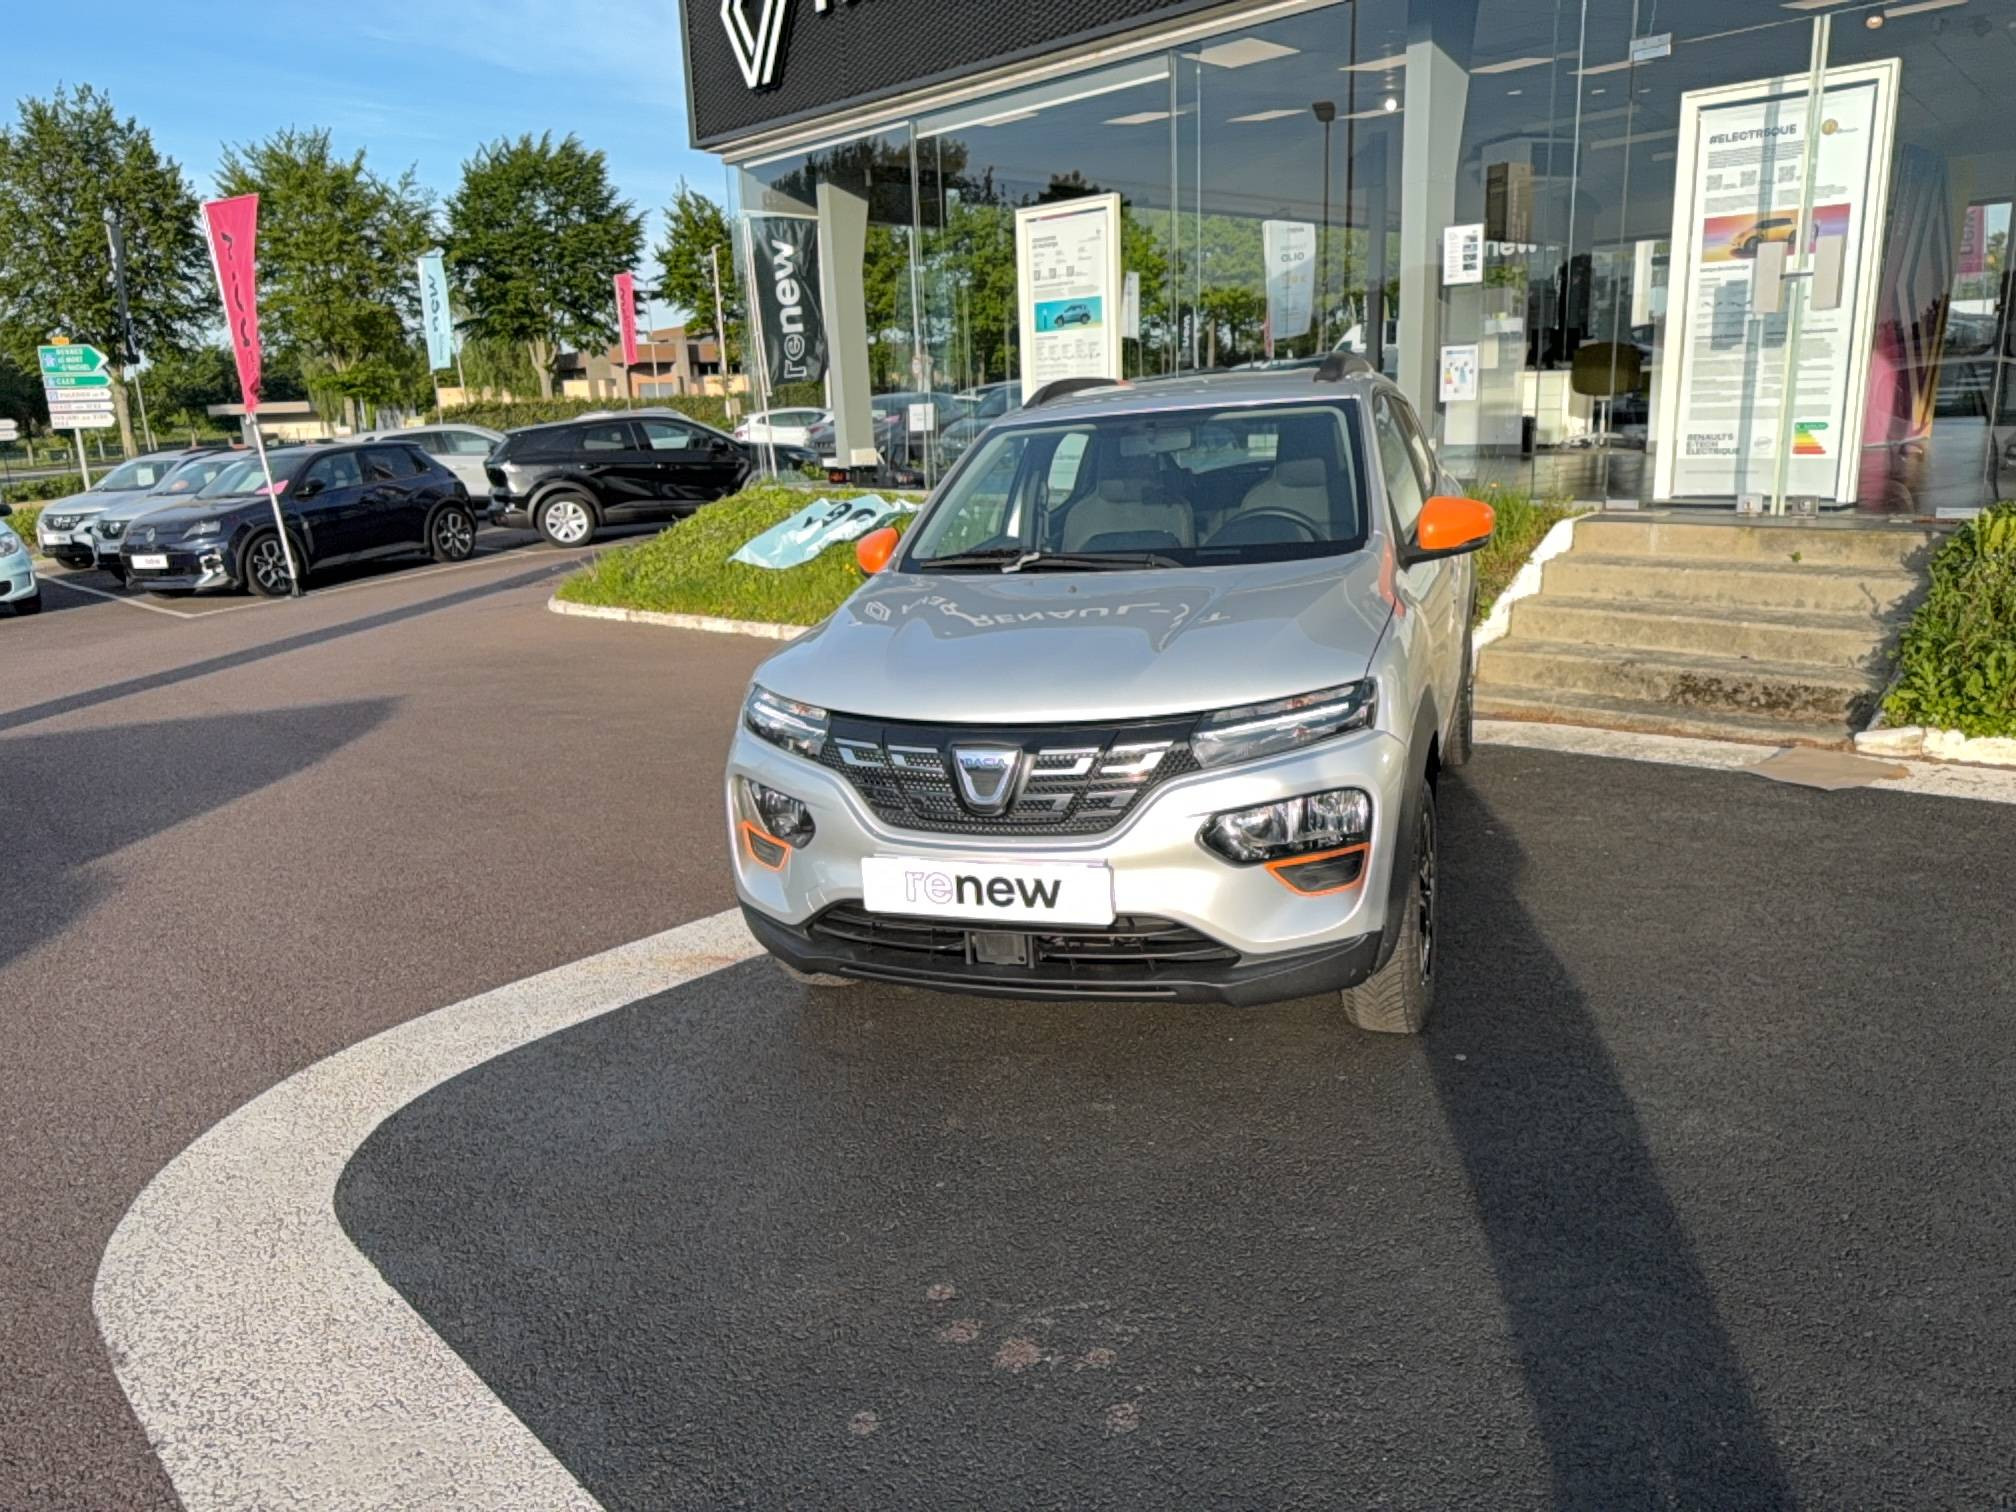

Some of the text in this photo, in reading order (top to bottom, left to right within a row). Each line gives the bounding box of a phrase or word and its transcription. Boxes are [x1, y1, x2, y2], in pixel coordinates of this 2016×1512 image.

[771, 239, 808, 379] renew
[963, 757, 1008, 769] DACIA
[904, 870, 1062, 909] renew
